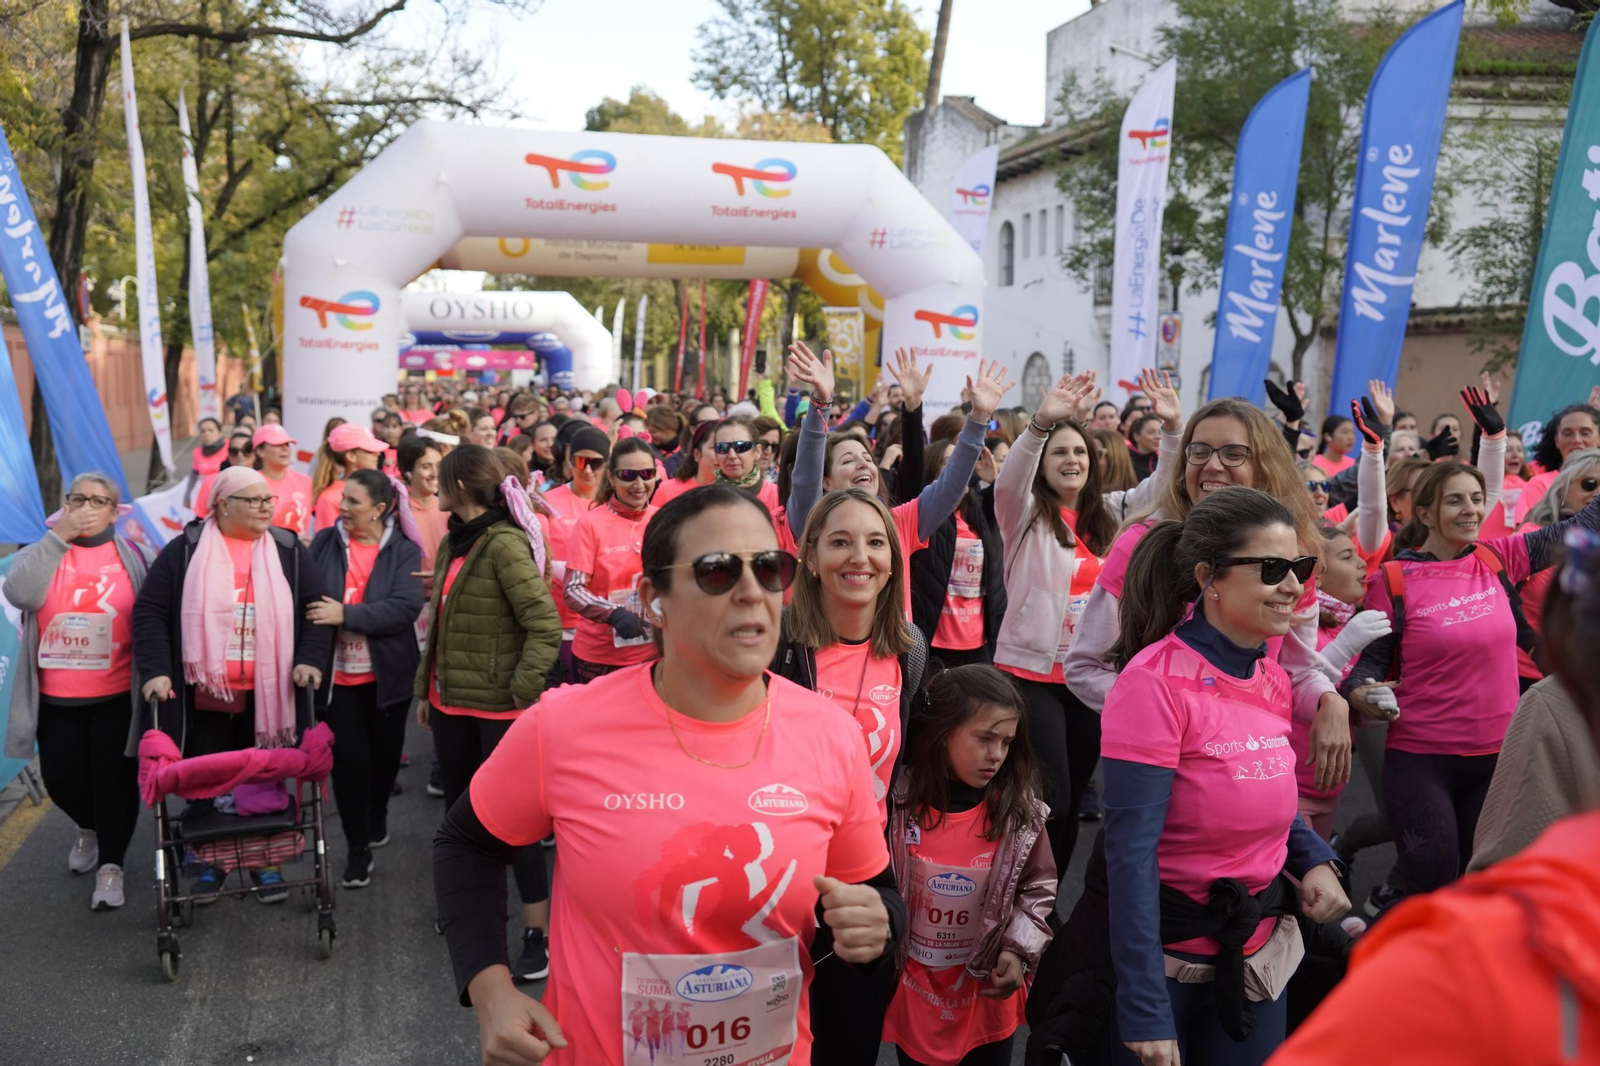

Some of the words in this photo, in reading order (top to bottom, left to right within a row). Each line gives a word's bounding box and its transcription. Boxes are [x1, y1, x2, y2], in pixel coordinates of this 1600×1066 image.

[524, 198, 617, 213] TotalEnergies
[711, 205, 797, 220] TotalEnergies
[1351, 143, 1420, 321] Marlene
[1225, 191, 1287, 343] Marlene
[430, 300, 533, 320] OYSHO
[298, 337, 380, 352] TotalEnergies
[1416, 602, 1448, 617] Sports
[63, 636, 90, 646] 016
[341, 641, 363, 650] 016
[1205, 740, 1246, 758] Sports
[604, 793, 684, 810] OYSHO
[928, 908, 969, 925] 016
[936, 931, 956, 940] 6311
[636, 984, 672, 996] SUMA
[686, 1016, 751, 1049] 016
[703, 1053, 735, 1066] 2280
[747, 1052, 774, 1066] SEVILLA
